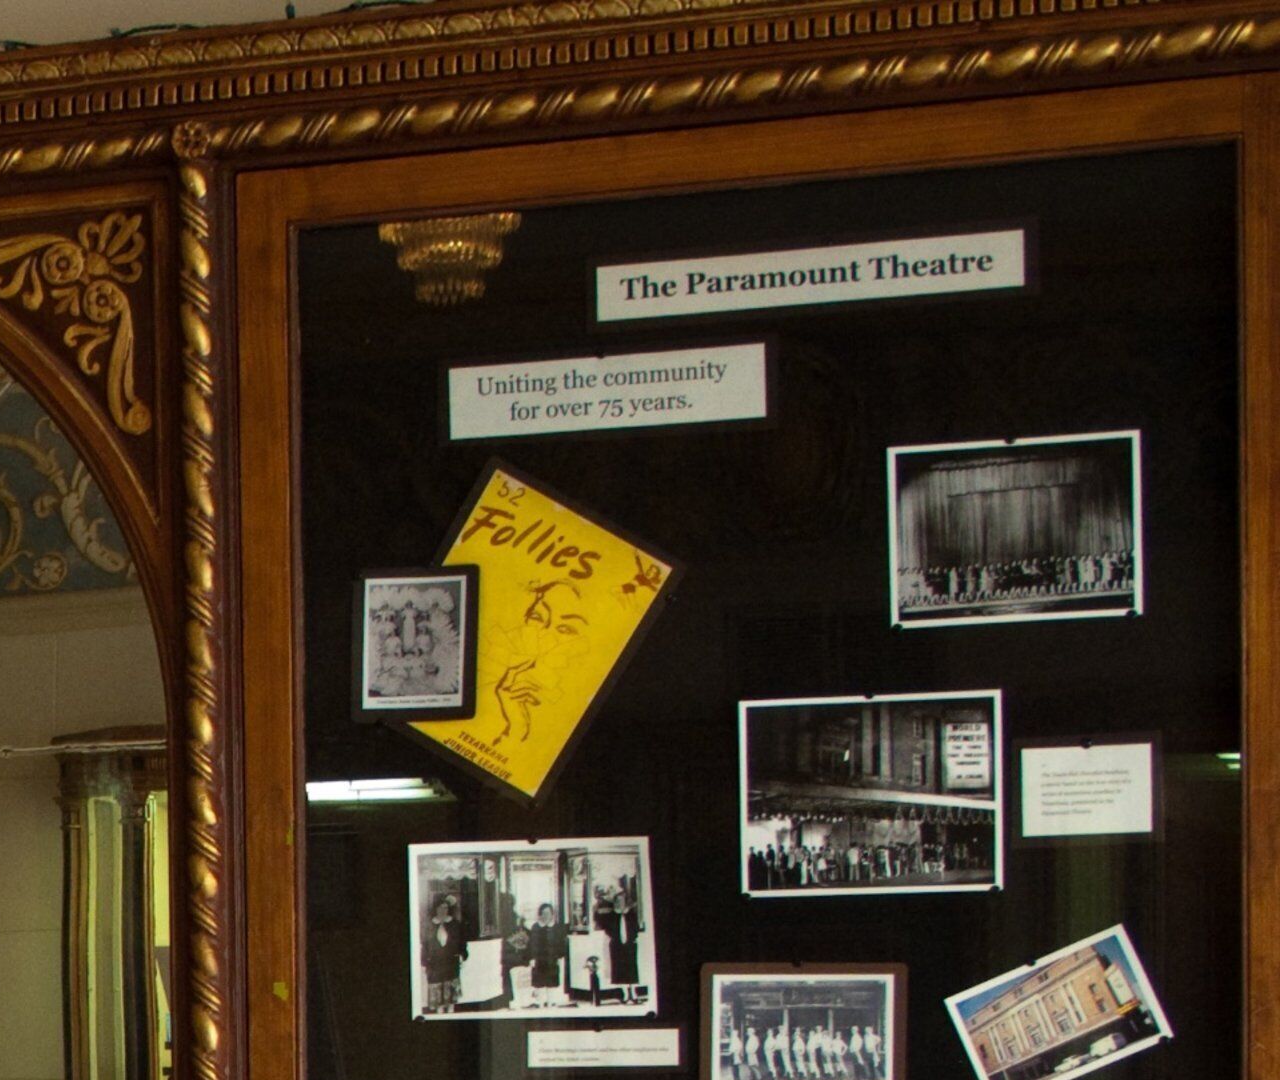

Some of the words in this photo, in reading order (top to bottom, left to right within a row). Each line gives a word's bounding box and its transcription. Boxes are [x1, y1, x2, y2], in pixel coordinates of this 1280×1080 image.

[620, 274, 678, 301] The
[685, 260, 861, 297] Paramount
[869, 250, 994, 283] Theatre
[477, 370, 558, 397] Uniting
[563, 367, 598, 390] the
[603, 358, 728, 388] community
[509, 401, 541, 422] for
[545, 403, 593, 419] over
[598, 399, 624, 420] 75
[628, 394, 694, 416] years.
[460, 504, 602, 580] Follies
[442, 736, 477, 759] JUNIOR
